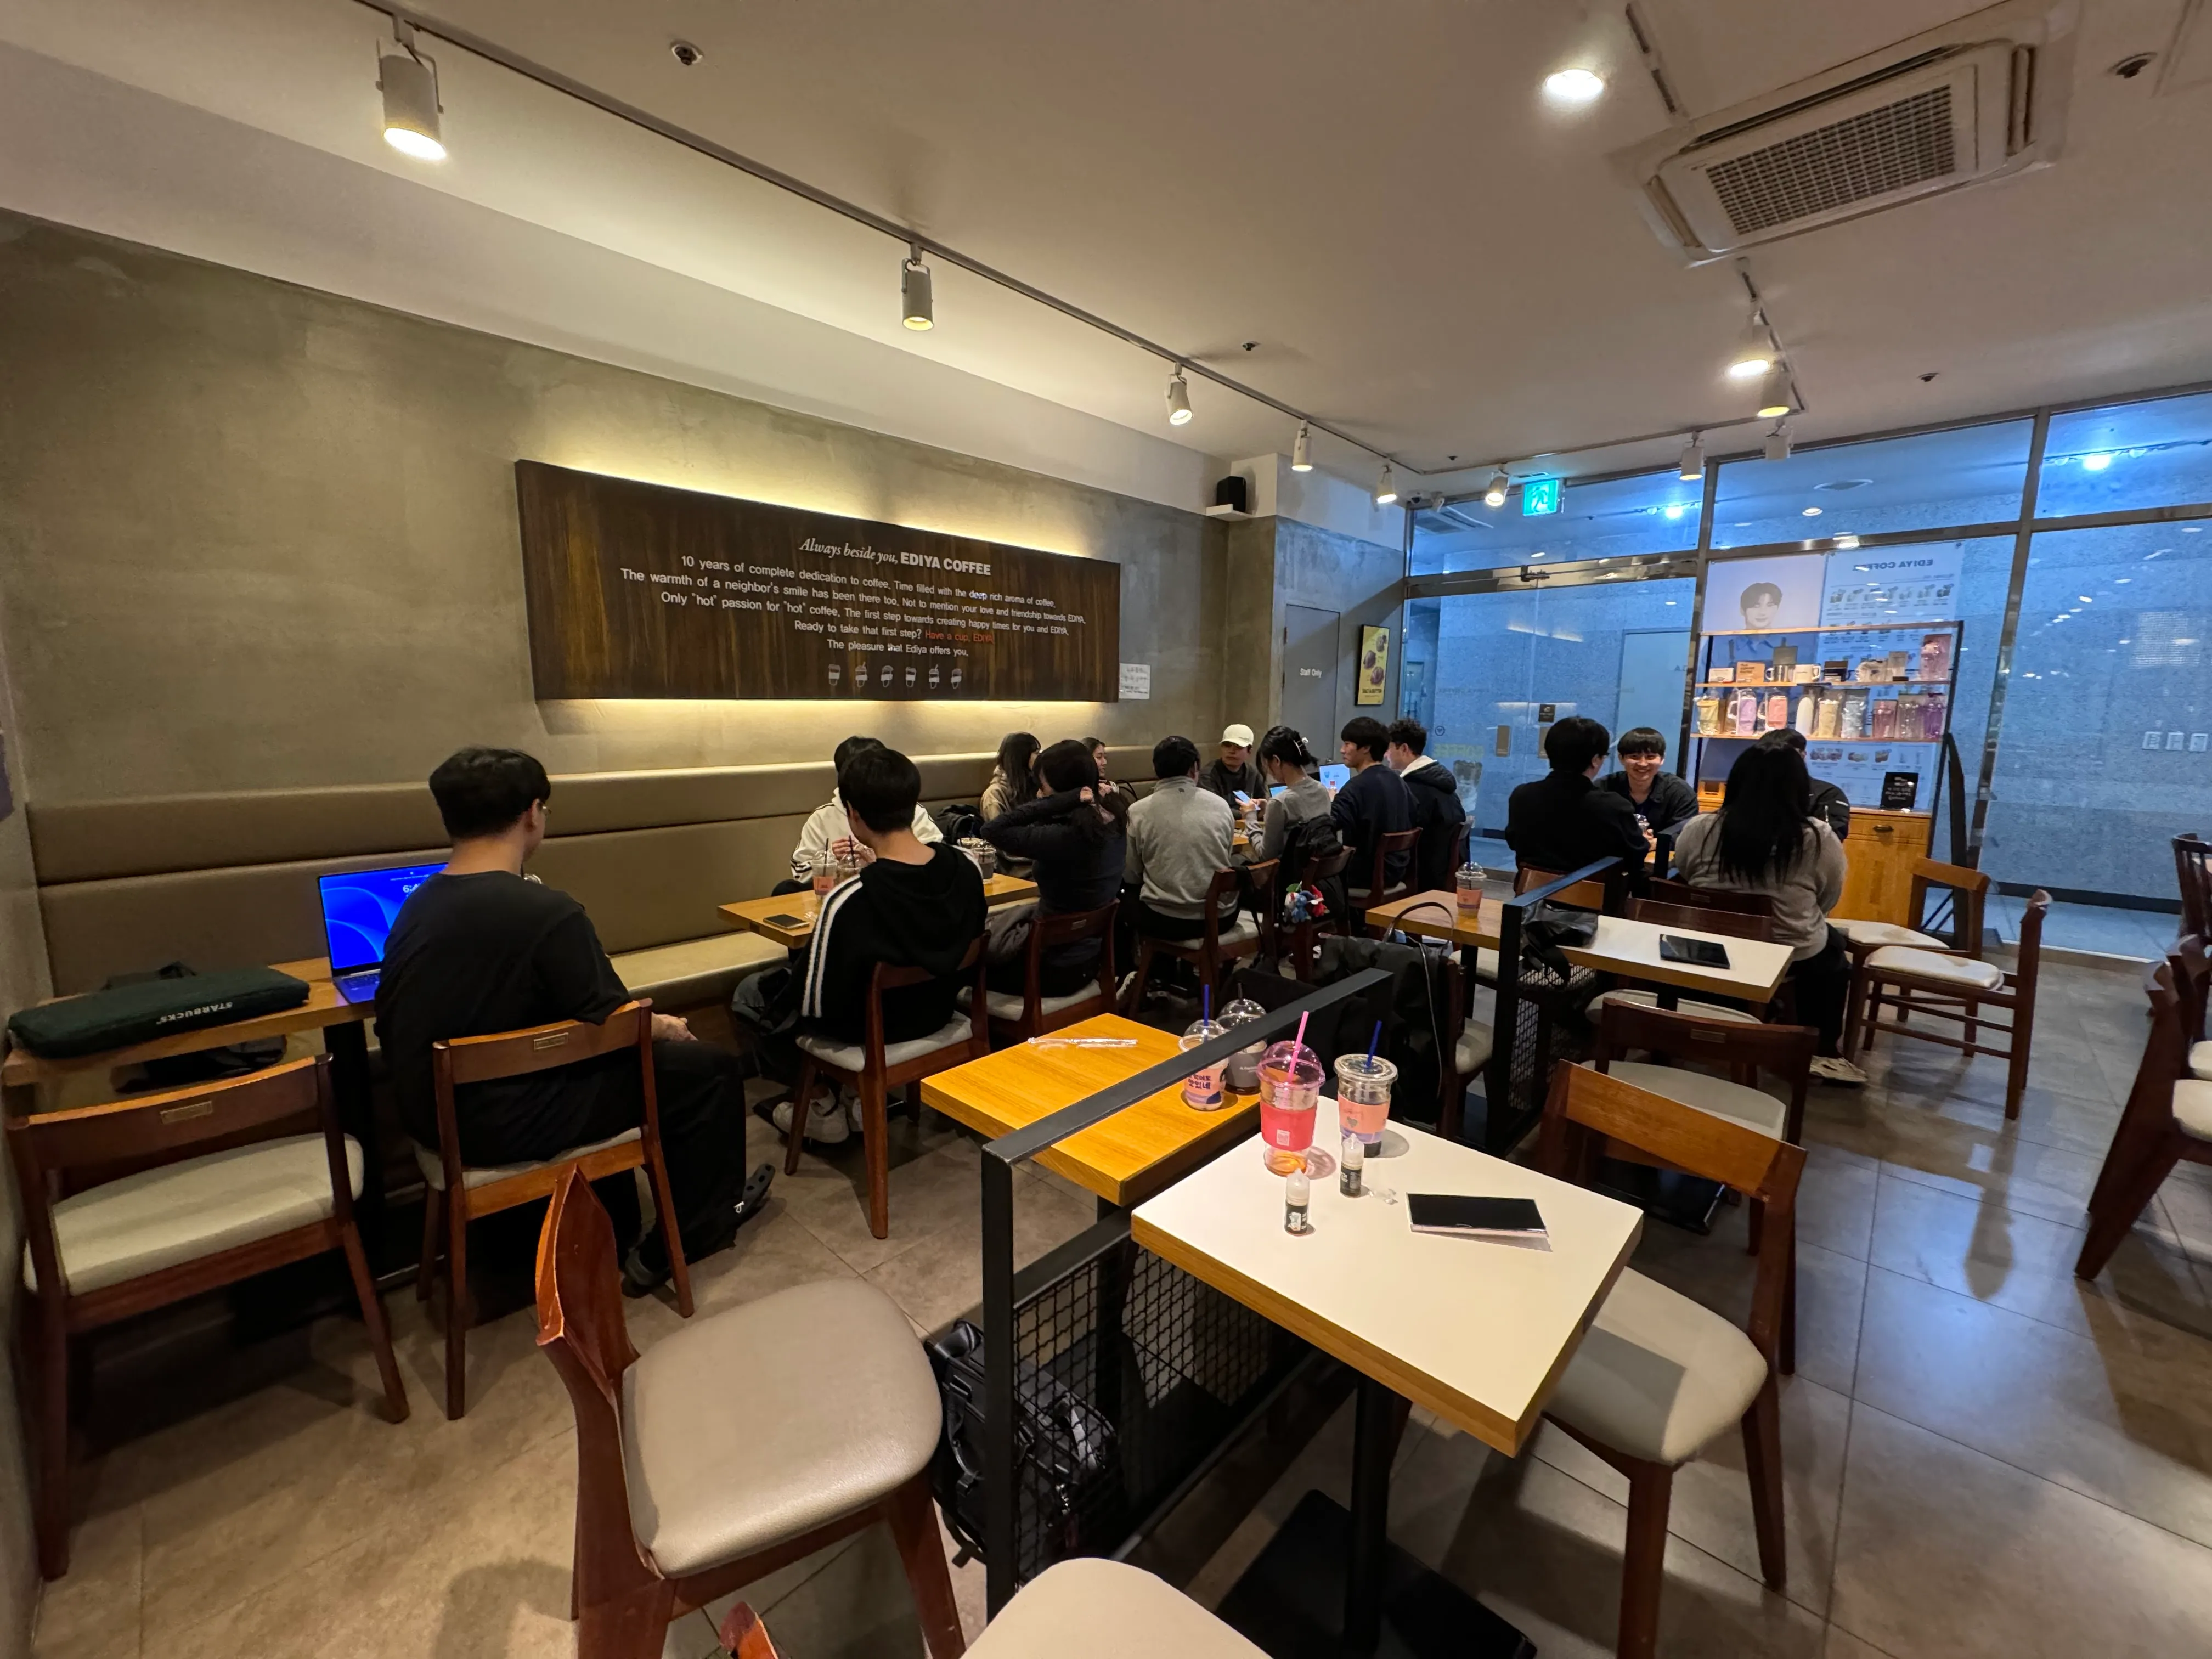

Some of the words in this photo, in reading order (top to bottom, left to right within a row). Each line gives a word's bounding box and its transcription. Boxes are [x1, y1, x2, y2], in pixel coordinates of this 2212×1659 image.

[799, 538, 842, 558] Always
[843, 543, 876, 560] beside
[876, 552, 898, 565] you,
[900, 551, 941, 569] EDIYA
[943, 558, 991, 575] COFFEE
[681, 555, 695, 567] 10
[699, 560, 730, 571] years
[734, 563, 745, 572] of
[749, 566, 795, 579] complete
[799, 569, 847, 584] dedication
[850, 575, 859, 585] to
[862, 578, 891, 590] coffee.
[894, 580, 913, 591] Time
[916, 583, 934, 594] filled
[938, 586, 952, 596] with
[955, 588, 966, 597] the
[969, 590, 988, 601] deep
[989, 592, 1002, 601] rich
[1005, 595, 1024, 604] aroma
[620, 568, 645, 582] The
[650, 574, 692, 586] warmth
[697, 577, 708, 587] of
[713, 579, 720, 588] a
[725, 580, 779, 594] neighbor's
[783, 586, 808, 596] smile
[812, 588, 829, 599] has
[832, 590, 855, 601] been
[859, 593, 881, 603] there
[884, 596, 900, 606] too.
[902, 597, 916, 607] Not
[919, 600, 927, 608] to
[930, 602, 958, 611] mention
[962, 605, 977, 614] your
[980, 606, 994, 614] love
[996, 607, 1008, 616] and
[1011, 608, 1042, 620] friendship
[1043, 612, 1066, 622] towards
[661, 591, 687, 606] Only
[692, 593, 718, 606] "hot"
[721, 598, 762, 611] passion
[766, 601, 780, 612] for
[783, 601, 806, 614] "hot"
[809, 605, 840, 617] coffee.
[844, 607, 861, 618] The
[864, 610, 880, 620] first
[883, 612, 901, 623] step
[904, 613, 934, 625] towards
[936, 617, 966, 628] creating
[968, 619, 990, 630] happy
[992, 620, 1009, 630] times
[1012, 623, 1020, 631] for
[1023, 625, 1035, 634] you
[1037, 625, 1048, 634] and
[794, 620, 823, 634] Ready
[827, 623, 837, 633] to
[840, 624, 859, 634] take
[862, 625, 879, 635] that
[882, 627, 898, 636] first
[899, 629, 922, 640] step?
[925, 630, 944, 640] Have
[827, 639, 844, 650] The
[848, 640, 884, 652] pleasure
[887, 643, 903, 652] that
[906, 644, 927, 656] Ediya
[930, 646, 951, 656] offers
[1300, 668, 1311, 676] Staff
[1312, 668, 1322, 678] Only
[160, 1002, 233, 1023] STARBUCKS
